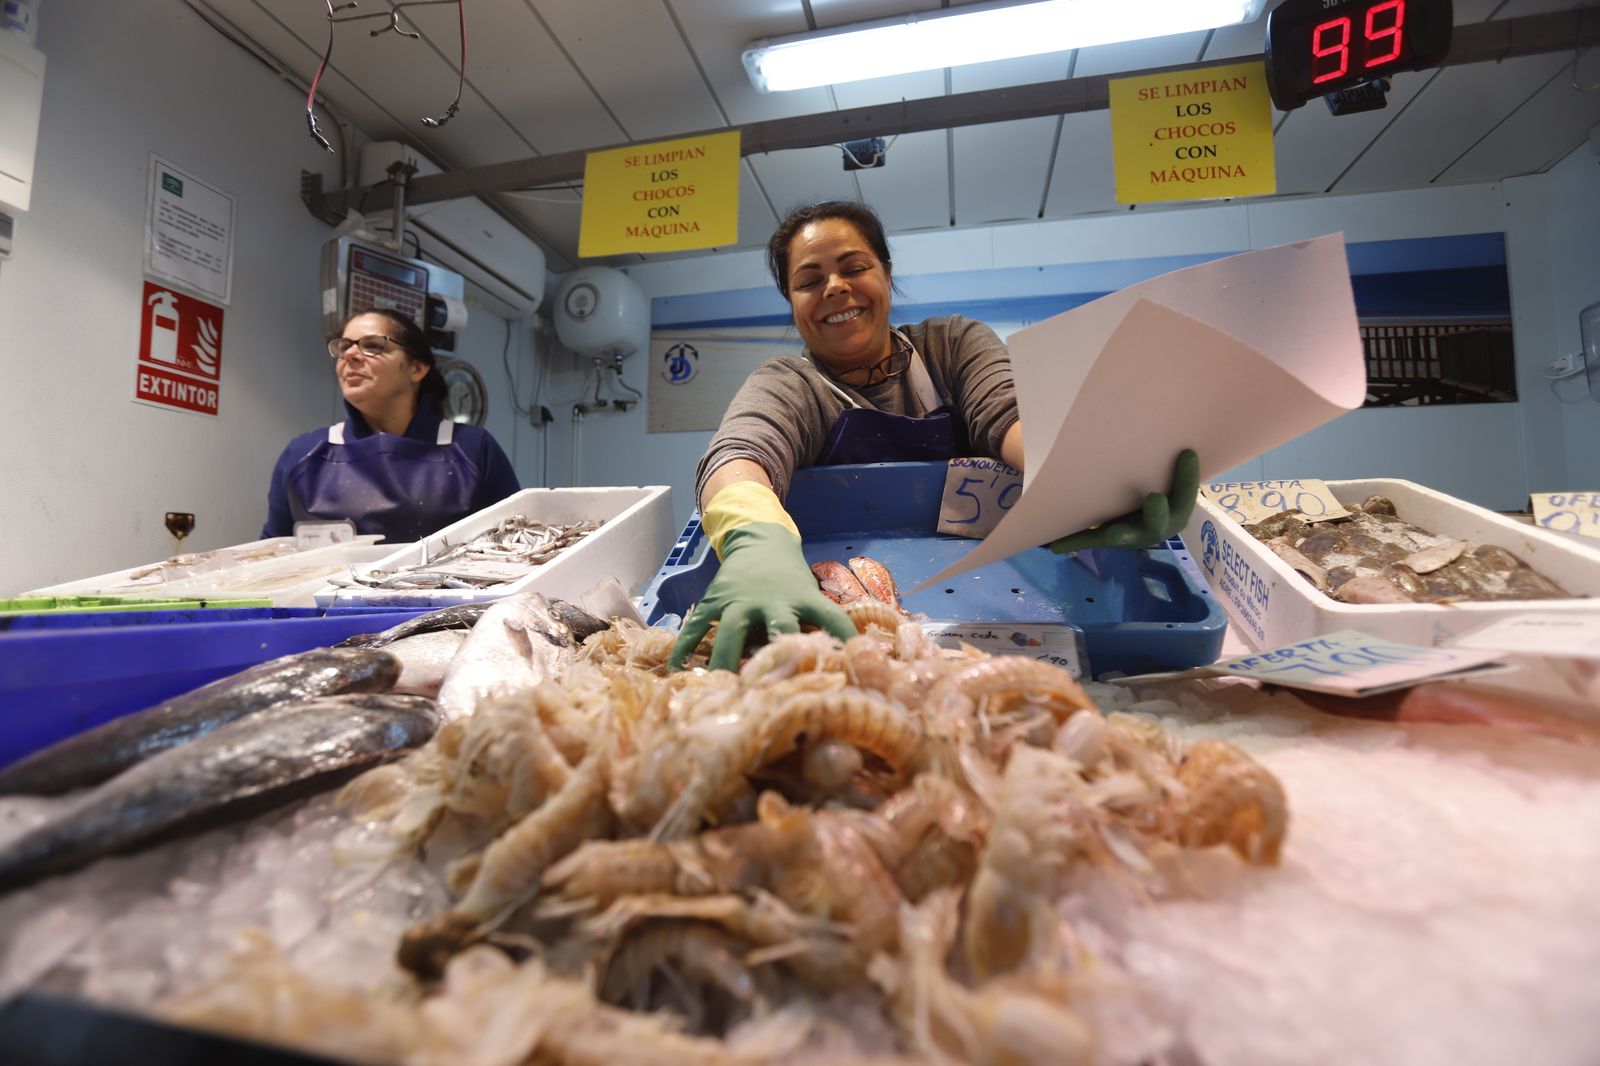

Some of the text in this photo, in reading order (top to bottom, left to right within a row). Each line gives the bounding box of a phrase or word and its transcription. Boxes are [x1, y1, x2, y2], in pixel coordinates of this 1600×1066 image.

[1312, 0, 1406, 85] 99
[1138, 77, 1248, 101] SE LIMPIAN
[1176, 102, 1212, 117] LOS
[1154, 122, 1236, 140] CHOCOS
[624, 146, 706, 168] SE LIMPIAN
[1175, 145, 1218, 160] CON
[651, 169, 679, 183] LOS
[1150, 164, 1247, 184] MÁQUINA
[632, 184, 696, 201] CHOCOS
[647, 205, 680, 219] CON
[625, 221, 701, 238] MÁQUINA
[140, 373, 217, 408] EXTINTOR
[1210, 480, 1304, 492] OFERTA
[1221, 538, 1250, 586] SELECT
[1250, 570, 1270, 611] FISH
[1228, 638, 1341, 672] OFERTA
